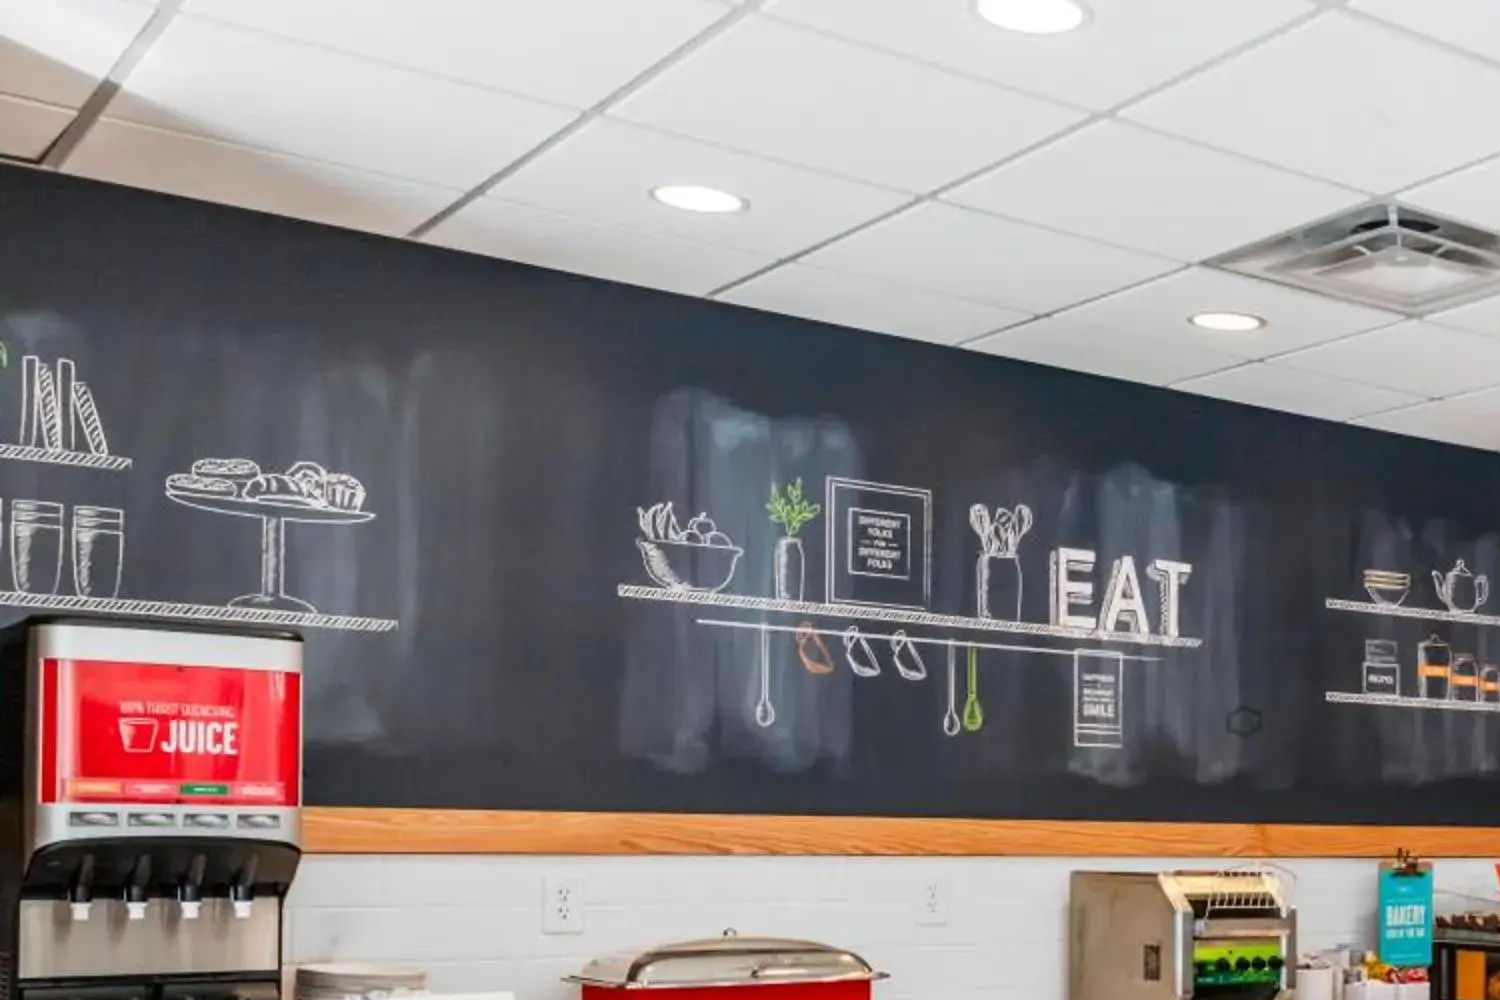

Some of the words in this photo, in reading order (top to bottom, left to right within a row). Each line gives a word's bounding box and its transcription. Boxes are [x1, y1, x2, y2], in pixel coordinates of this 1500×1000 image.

[1049, 547, 1192, 639] EAT
[161, 719, 239, 755] JUICE
[1385, 905, 1426, 926] BAKERY
